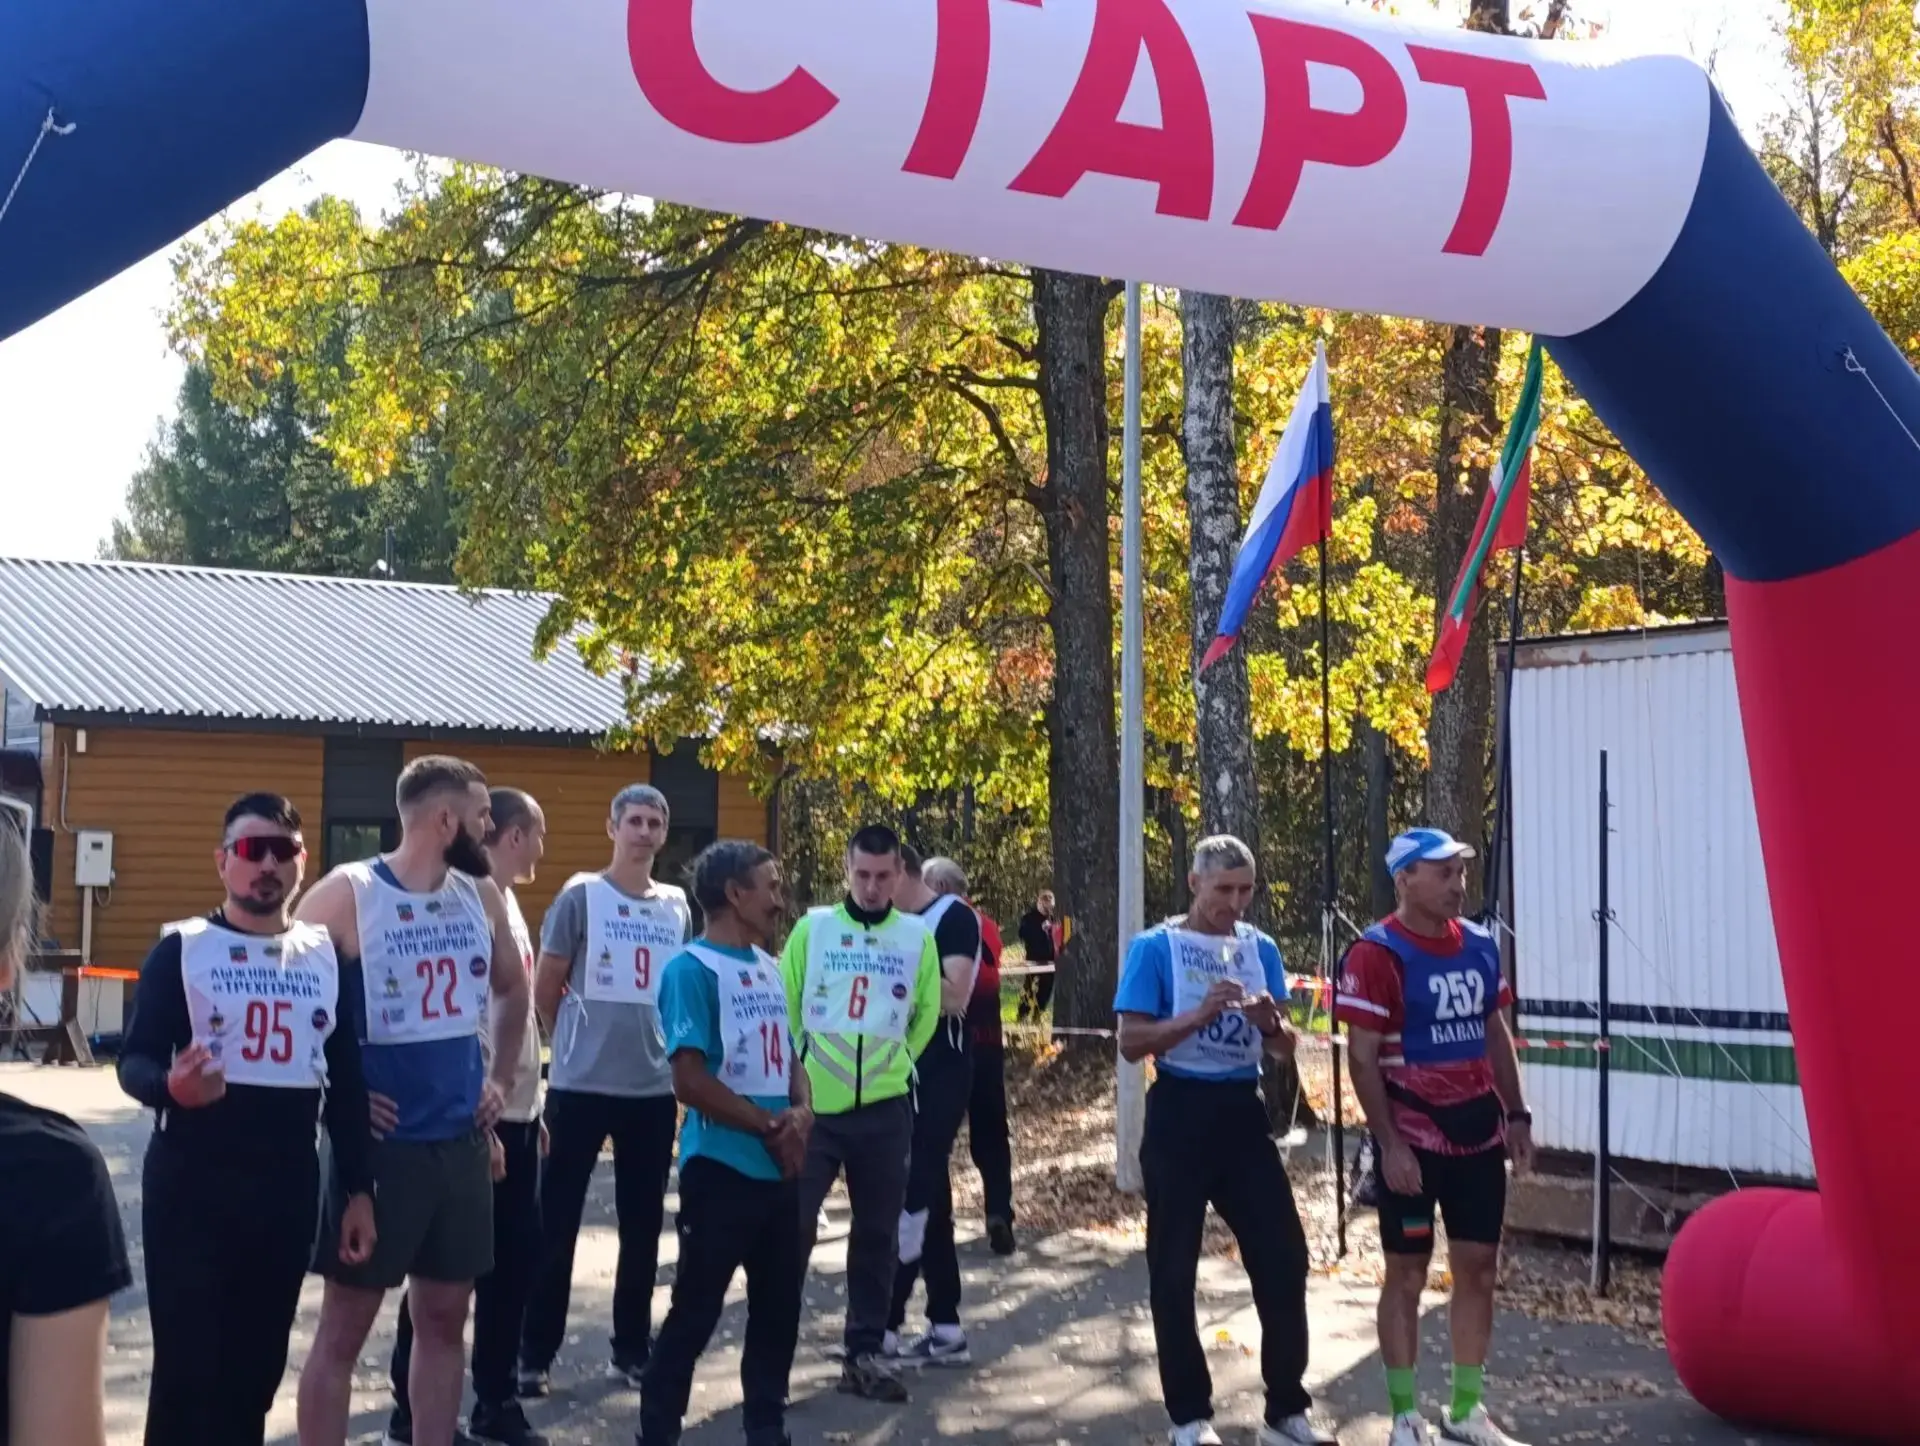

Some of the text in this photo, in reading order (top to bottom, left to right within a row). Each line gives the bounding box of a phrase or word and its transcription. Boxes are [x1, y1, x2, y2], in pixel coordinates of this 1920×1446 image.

[627, 0, 1548, 256] СТАРТ
[211, 966, 277, 981] ЛЫЖНАЯ
[416, 956, 462, 1021] 22
[635, 946, 650, 990] 9
[1428, 968, 1485, 1021] 252
[848, 975, 869, 1020] 6
[241, 1000, 293, 1065] 95
[759, 1020, 784, 1078] 14
